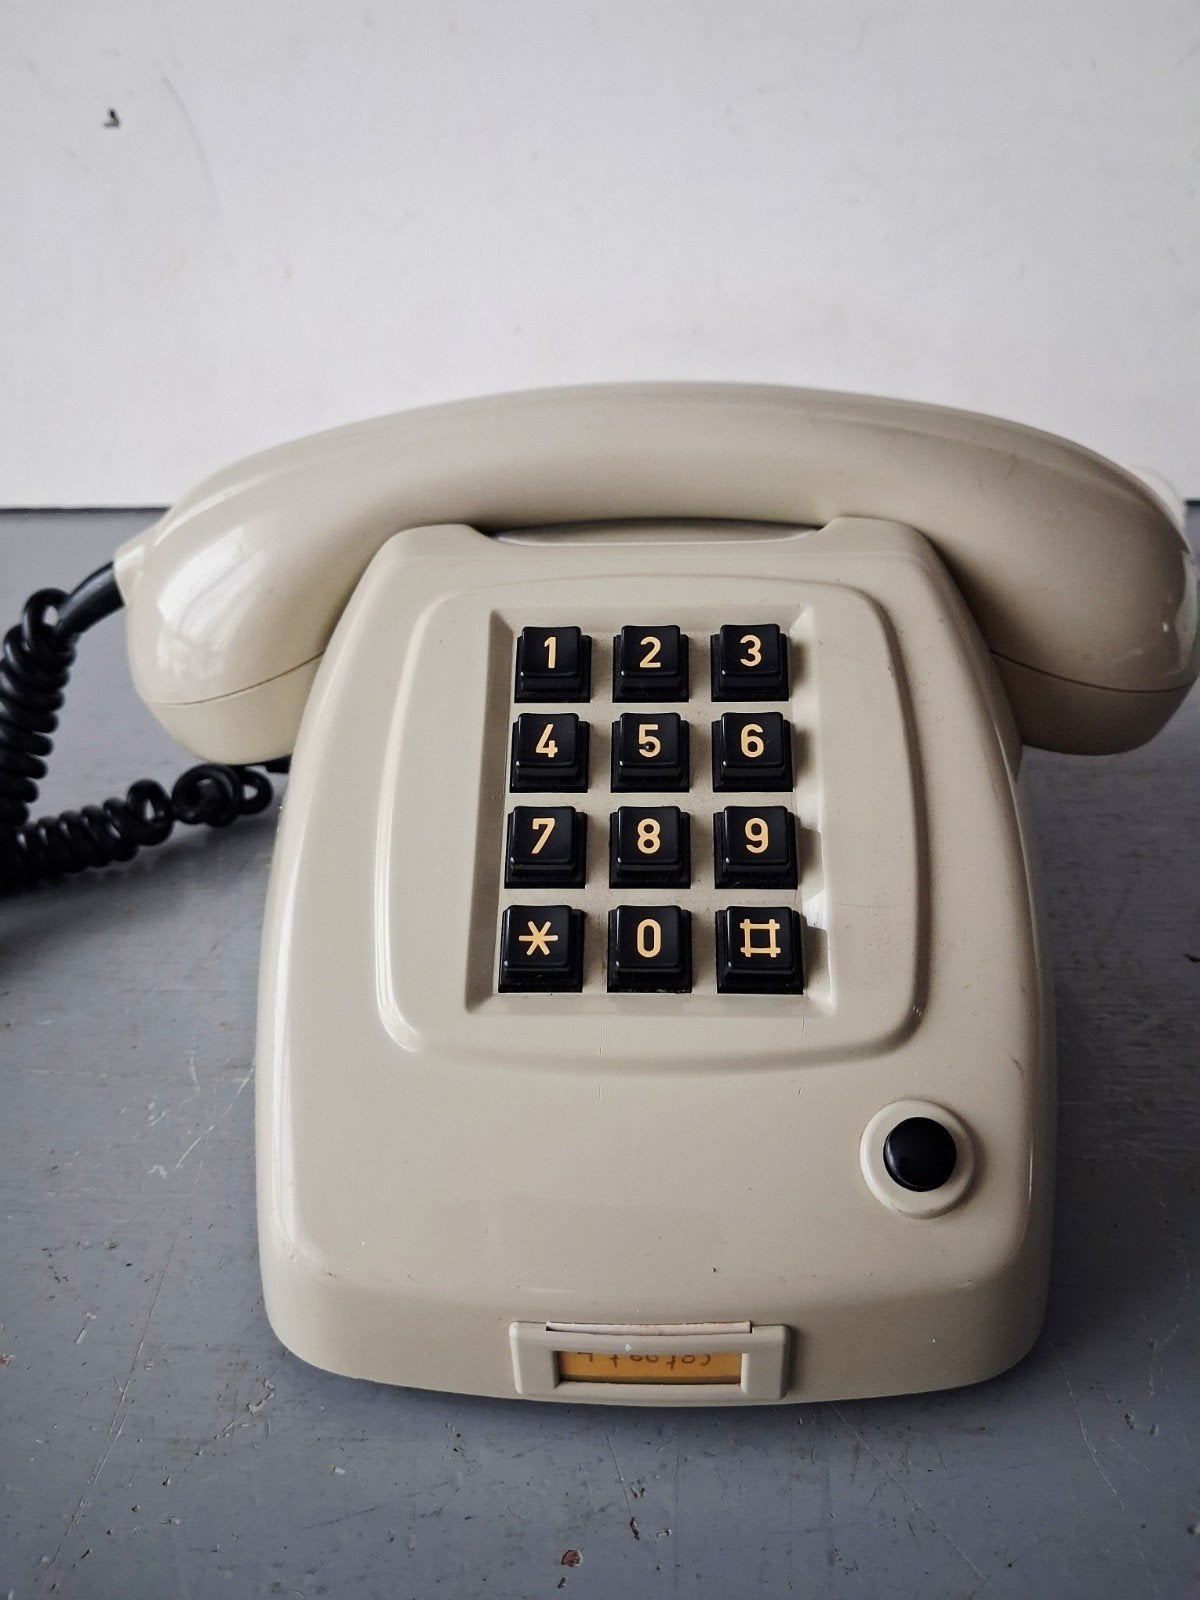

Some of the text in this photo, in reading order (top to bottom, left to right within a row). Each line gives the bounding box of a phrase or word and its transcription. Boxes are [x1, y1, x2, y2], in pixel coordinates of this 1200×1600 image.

[544, 636, 557, 669] 1
[639, 636, 661, 668] 2
[739, 634, 762, 667] 3
[535, 723, 559, 758] 4
[638, 723, 661, 758] 5
[740, 723, 764, 758] 6
[531, 817, 556, 854] 7
[637, 817, 661, 854] 8
[744, 817, 769, 854] 9
[636, 918, 662, 958] 0
